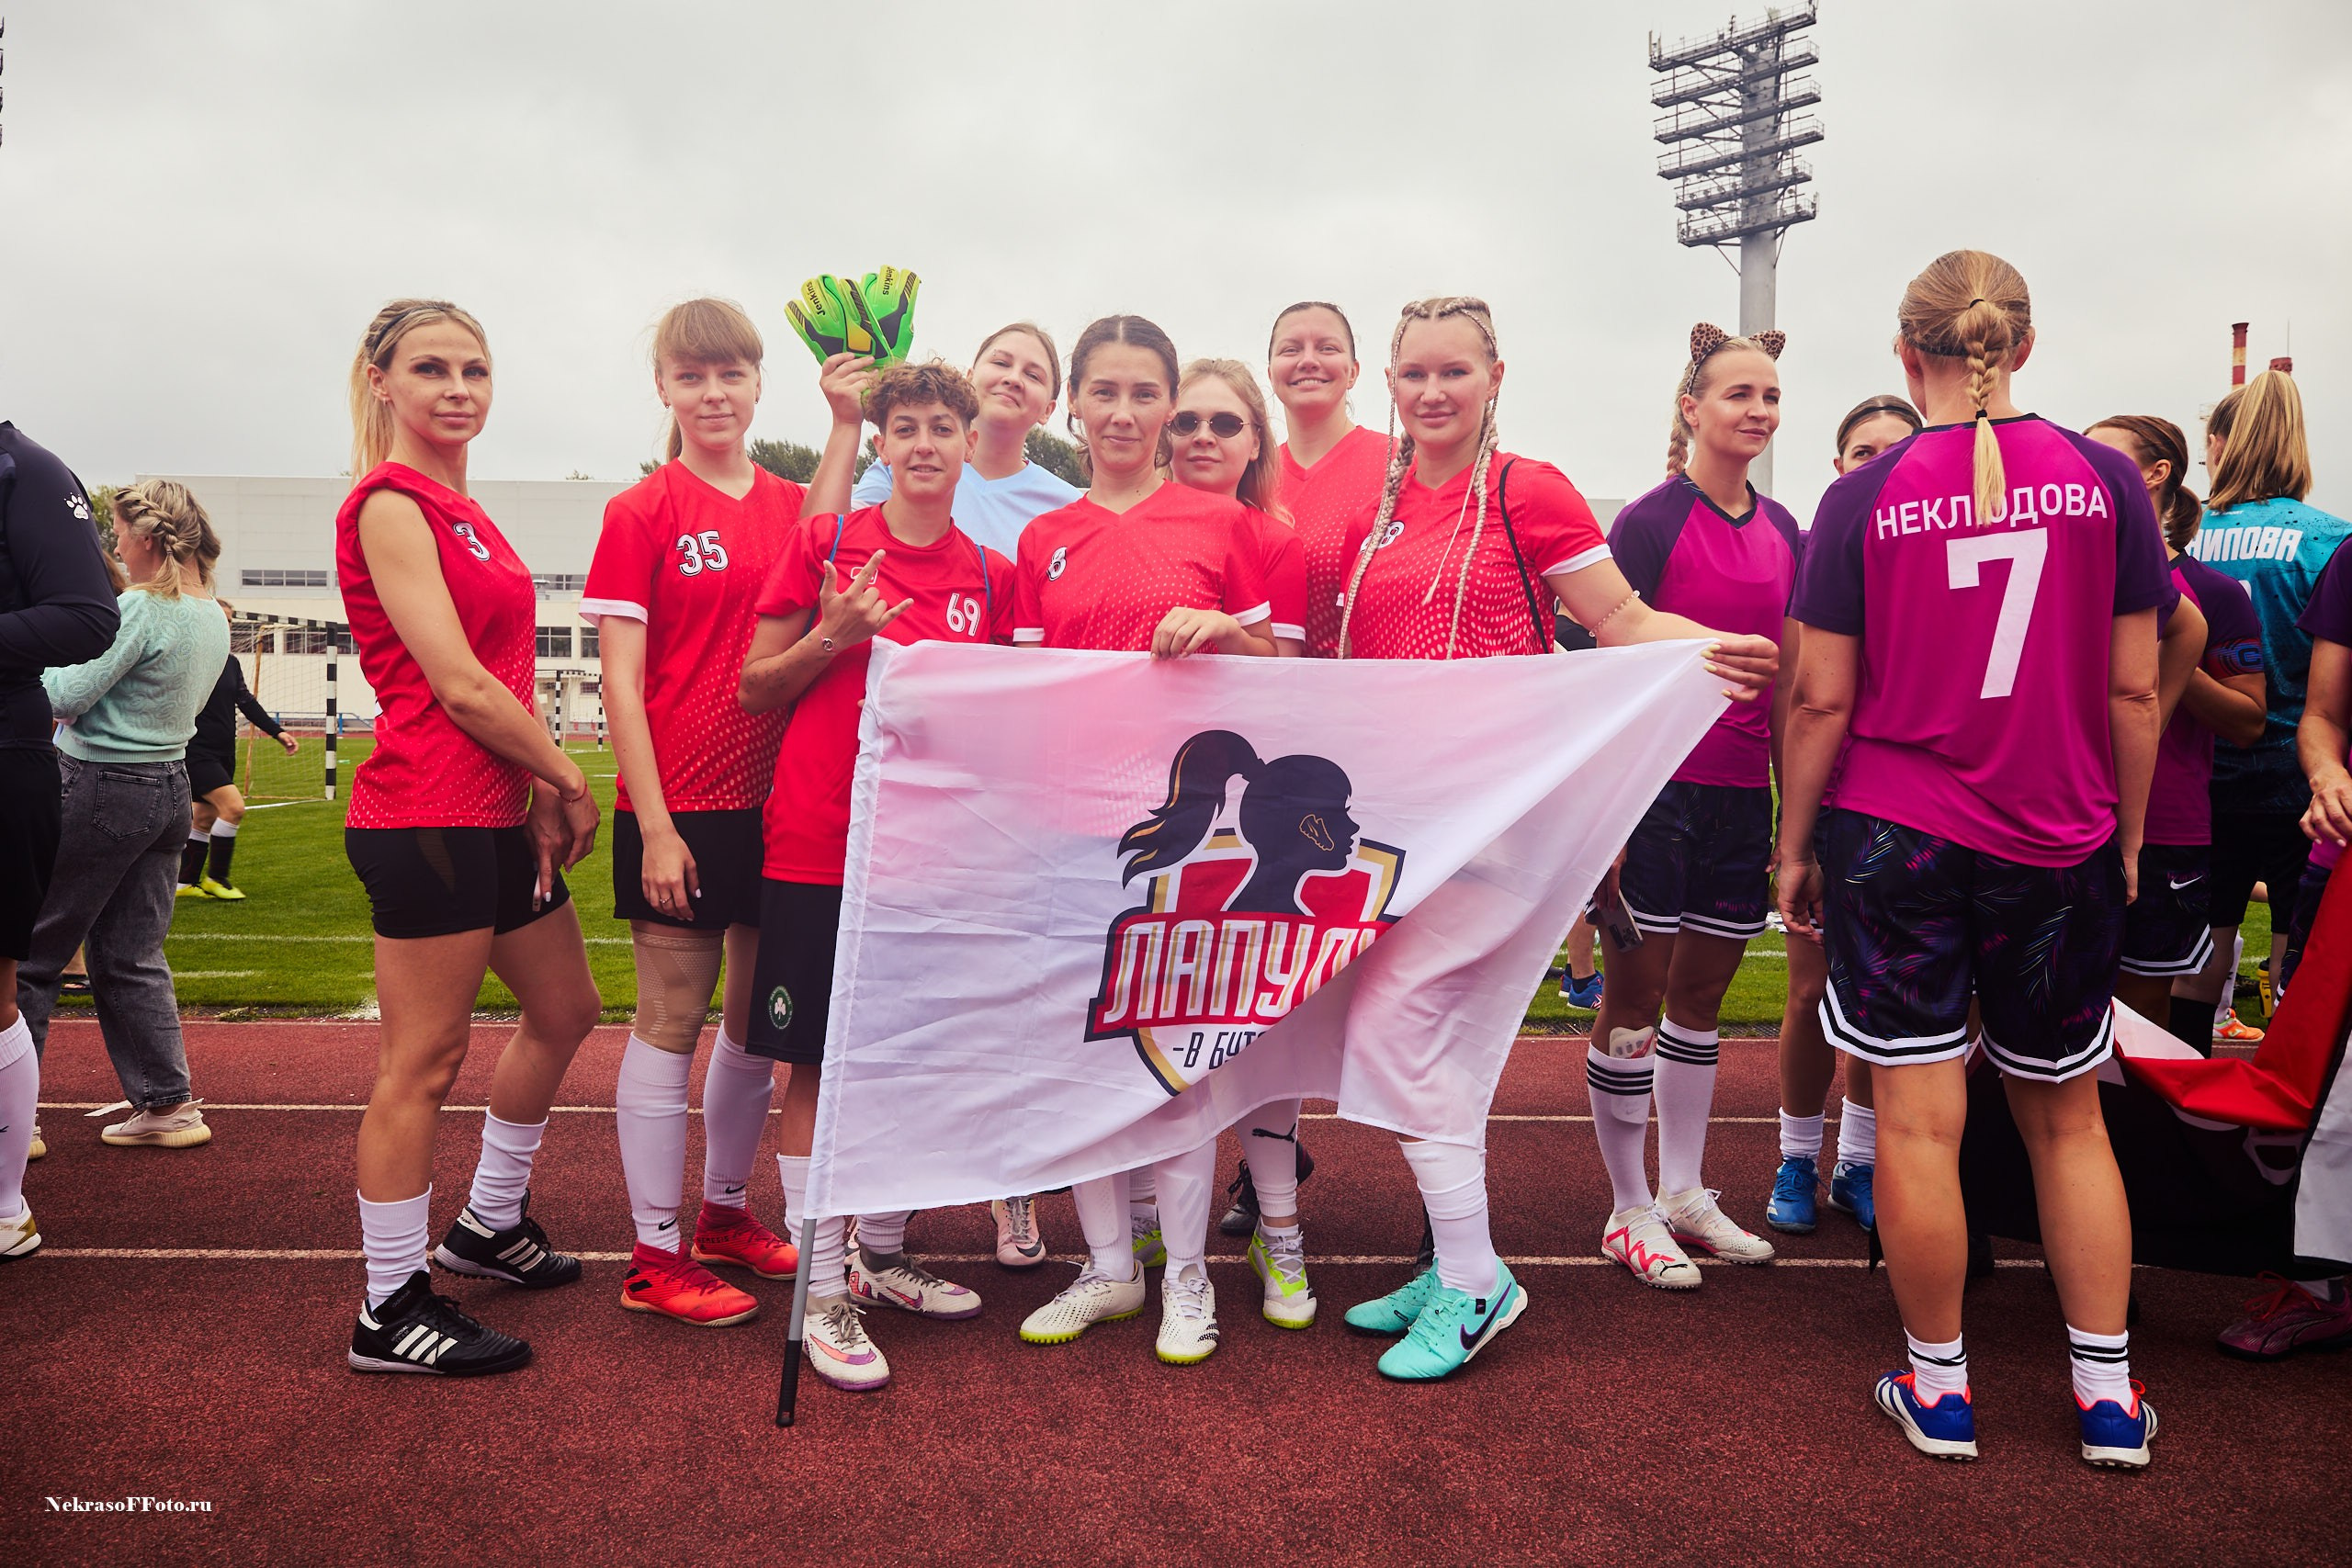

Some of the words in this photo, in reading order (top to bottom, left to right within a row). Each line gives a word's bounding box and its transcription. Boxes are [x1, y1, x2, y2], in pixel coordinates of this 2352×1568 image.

[806, 281, 826, 315] Jenkins
[452, 521, 491, 561] 3
[675, 529, 729, 577] 35
[946, 592, 981, 637] 69
[1946, 527, 2048, 699] 7
